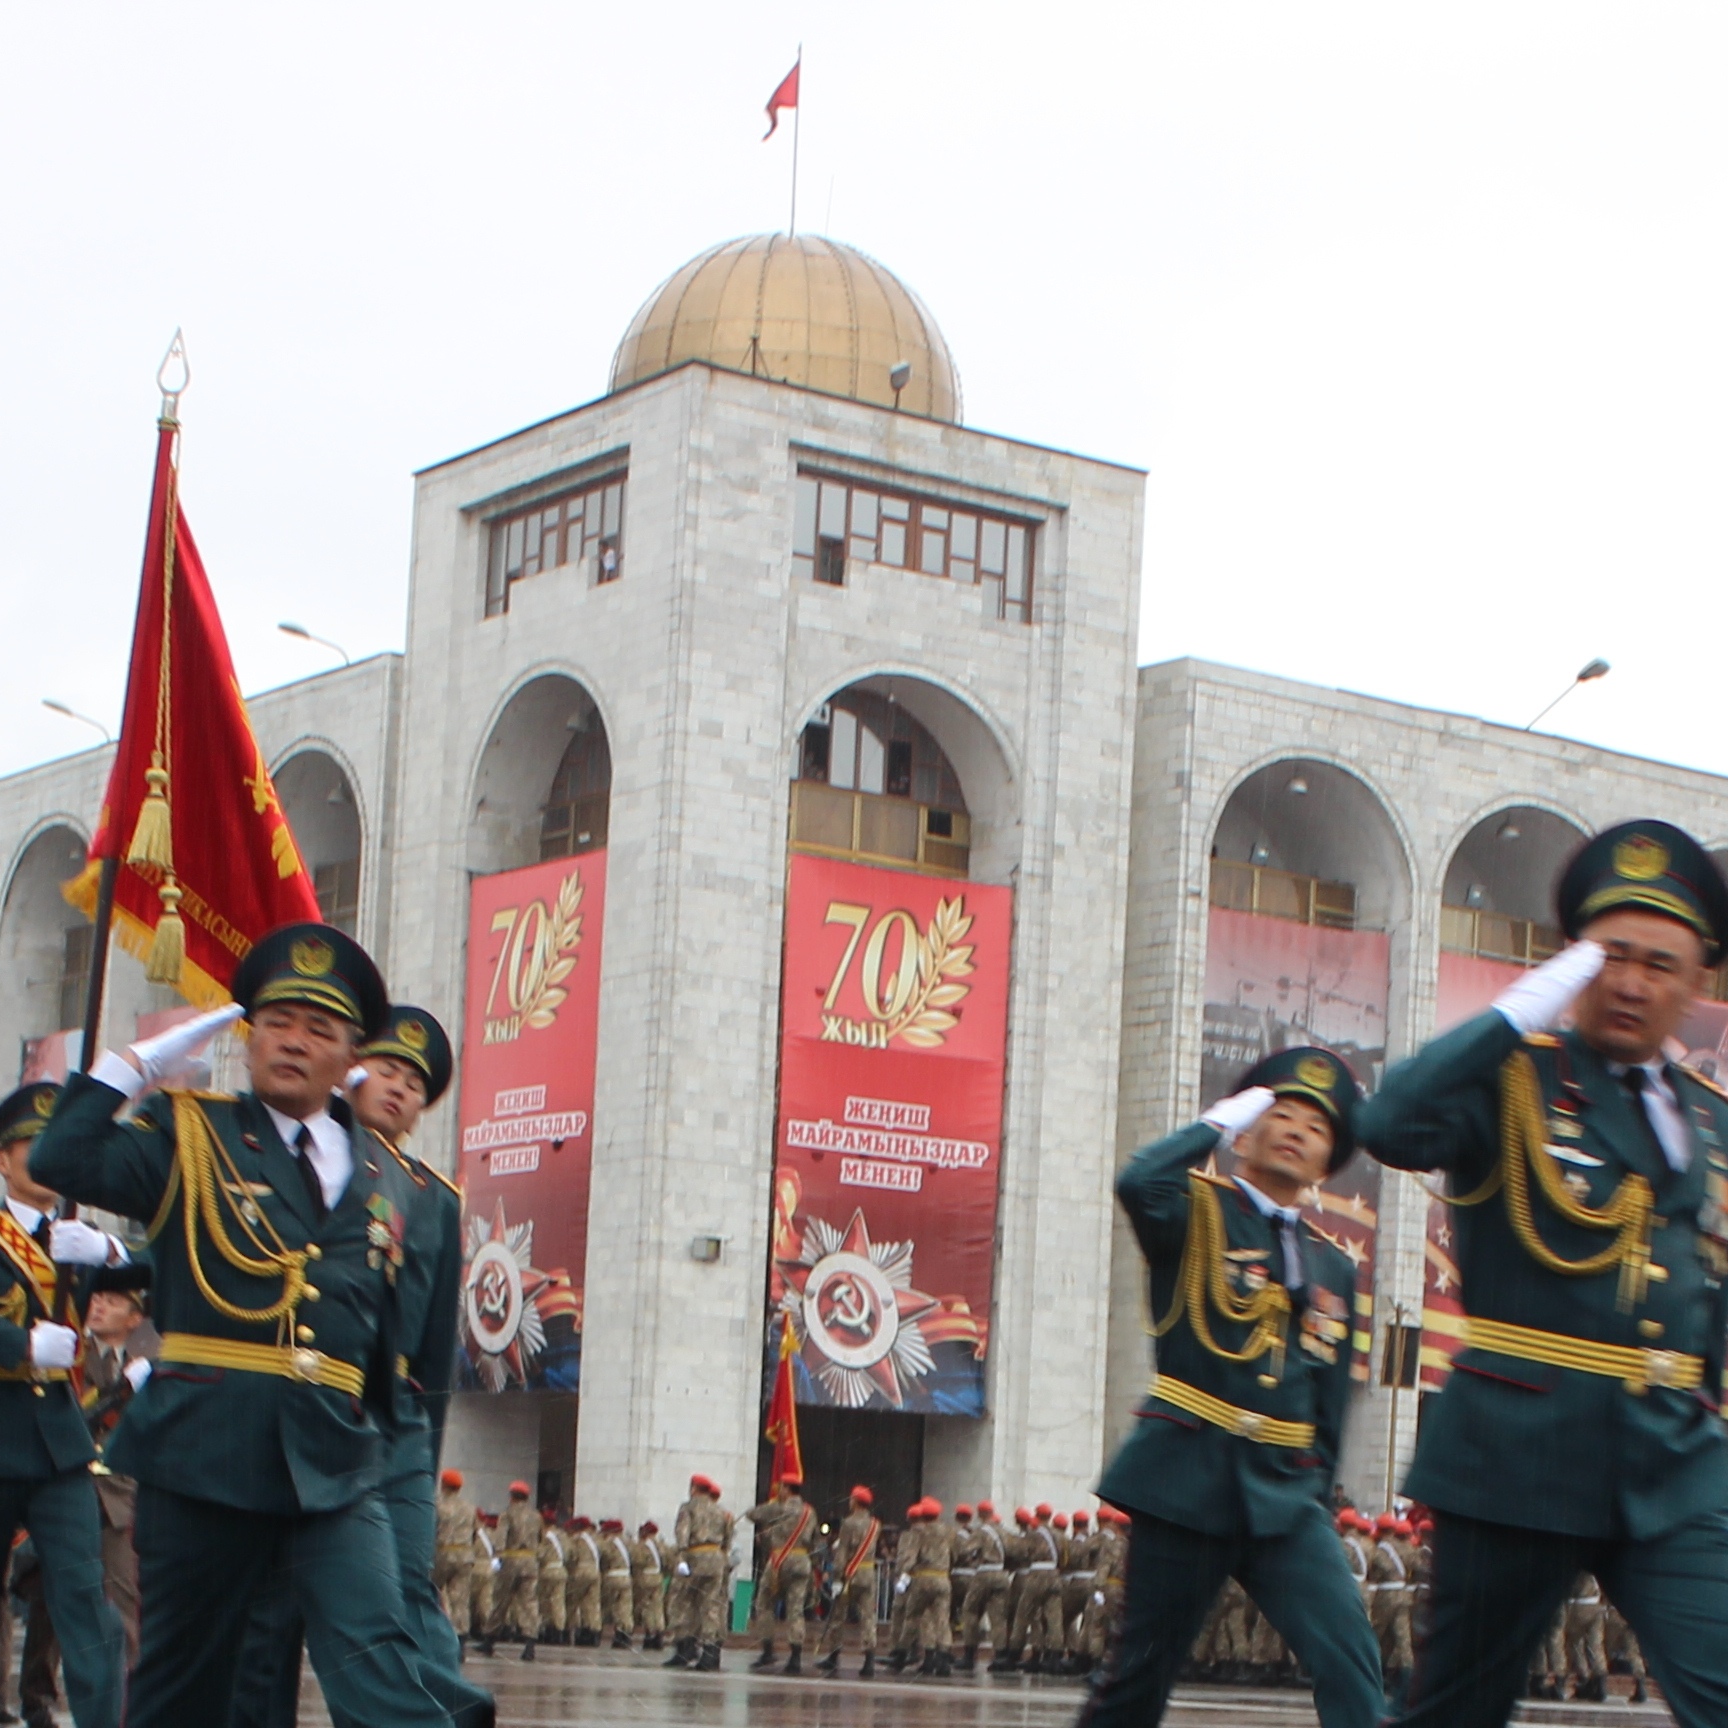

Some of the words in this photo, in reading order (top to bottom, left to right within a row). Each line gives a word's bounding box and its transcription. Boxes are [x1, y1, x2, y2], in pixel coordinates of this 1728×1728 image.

[485, 900, 548, 1017] 70
[824, 901, 919, 1021] 70
[821, 1014, 888, 1049] ЖЫЛ
[847, 1098, 928, 1128] ЖЕҢИШ
[492, 1148, 539, 1172] МЕНЕН!
[788, 1123, 988, 1167] МАЙРАМЫҢЫЗДАР
[843, 1162, 921, 1189] МЕНЕН!
